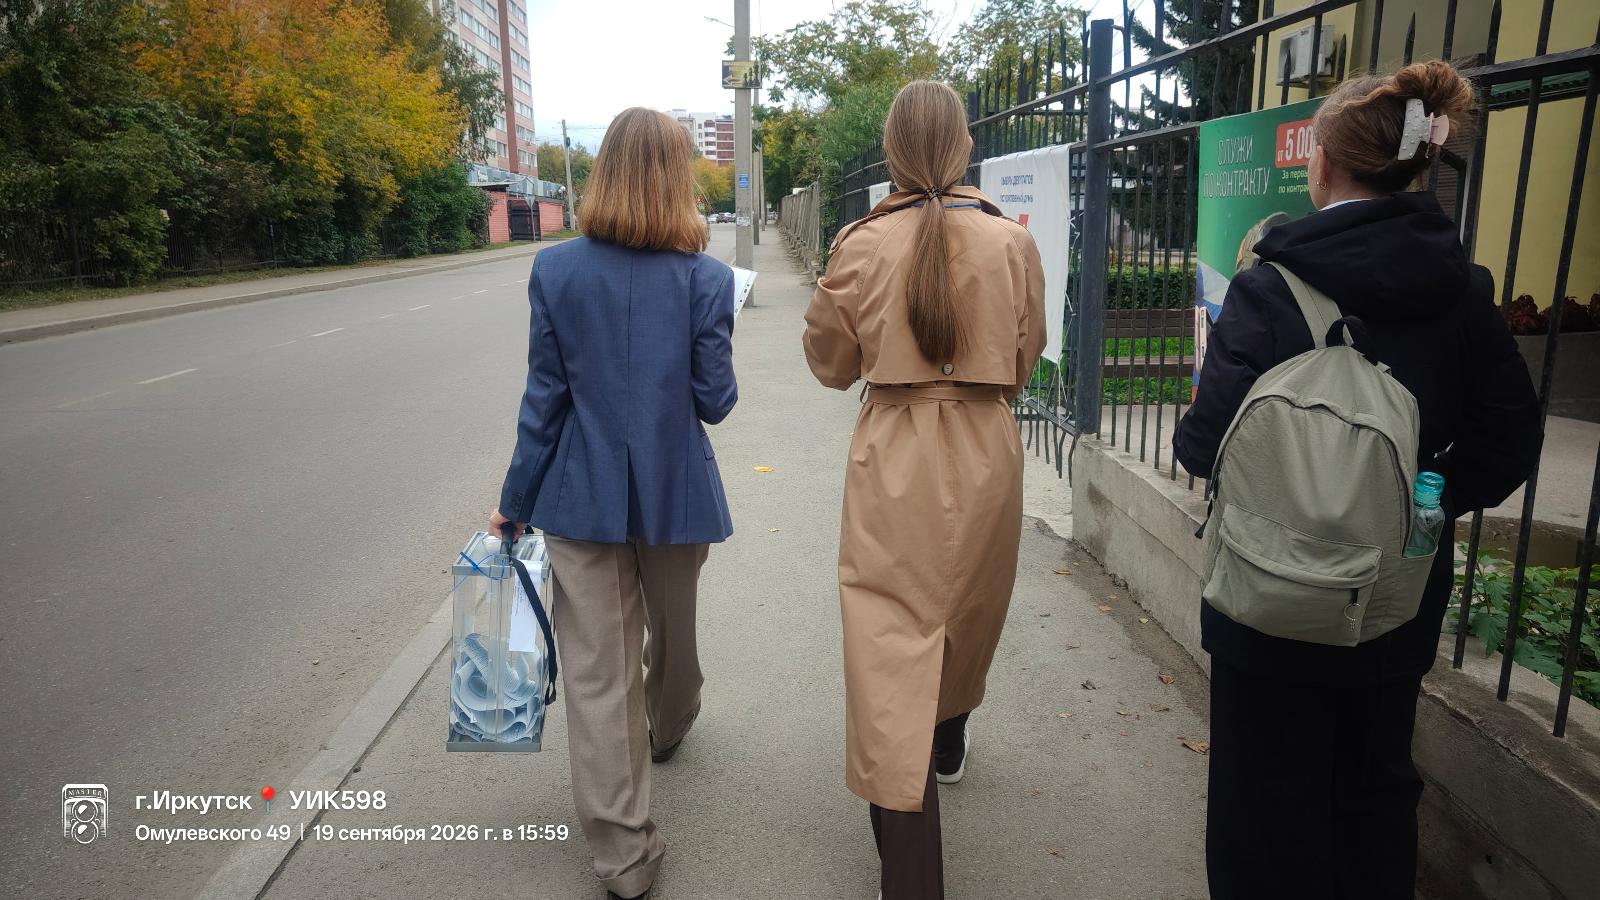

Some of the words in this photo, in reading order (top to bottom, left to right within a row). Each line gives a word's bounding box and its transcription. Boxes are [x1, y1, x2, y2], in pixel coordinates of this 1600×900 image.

[1218, 135, 1253, 165] СЛУЖИ
[1286, 128, 1294, 161] 5
[1204, 173, 1215, 198] ПО
[1215, 167, 1270, 197] КОНТРАКТУ
[1281, 169, 1289, 179] За
[1278, 185, 1286, 194] по
